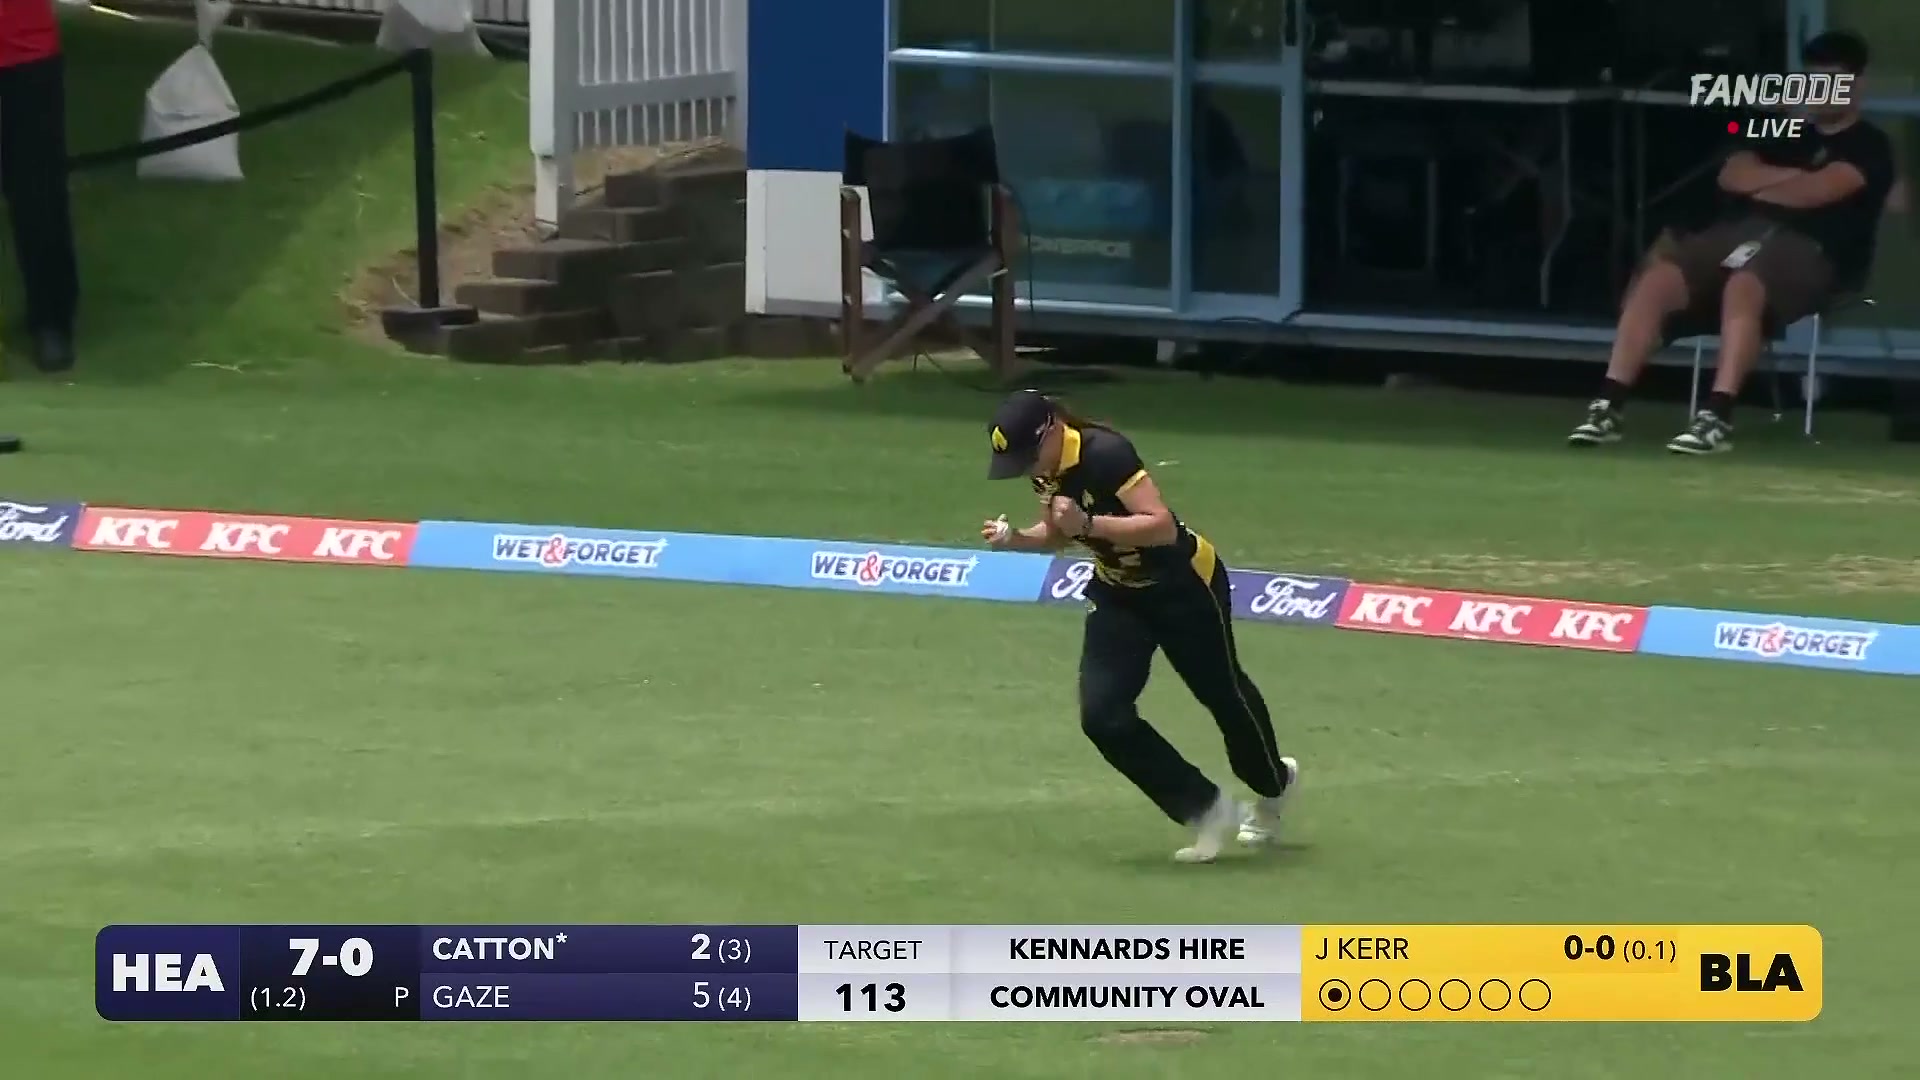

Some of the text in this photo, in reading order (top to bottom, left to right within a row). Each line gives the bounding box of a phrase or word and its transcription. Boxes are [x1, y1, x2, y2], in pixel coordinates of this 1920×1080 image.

[90, 516, 401, 560] KFC KFC KFC
[813, 552, 970, 584] WET&FORGET
[1250, 577, 1338, 619] Ford
[1350, 593, 1633, 643] KFC KFC KFC
